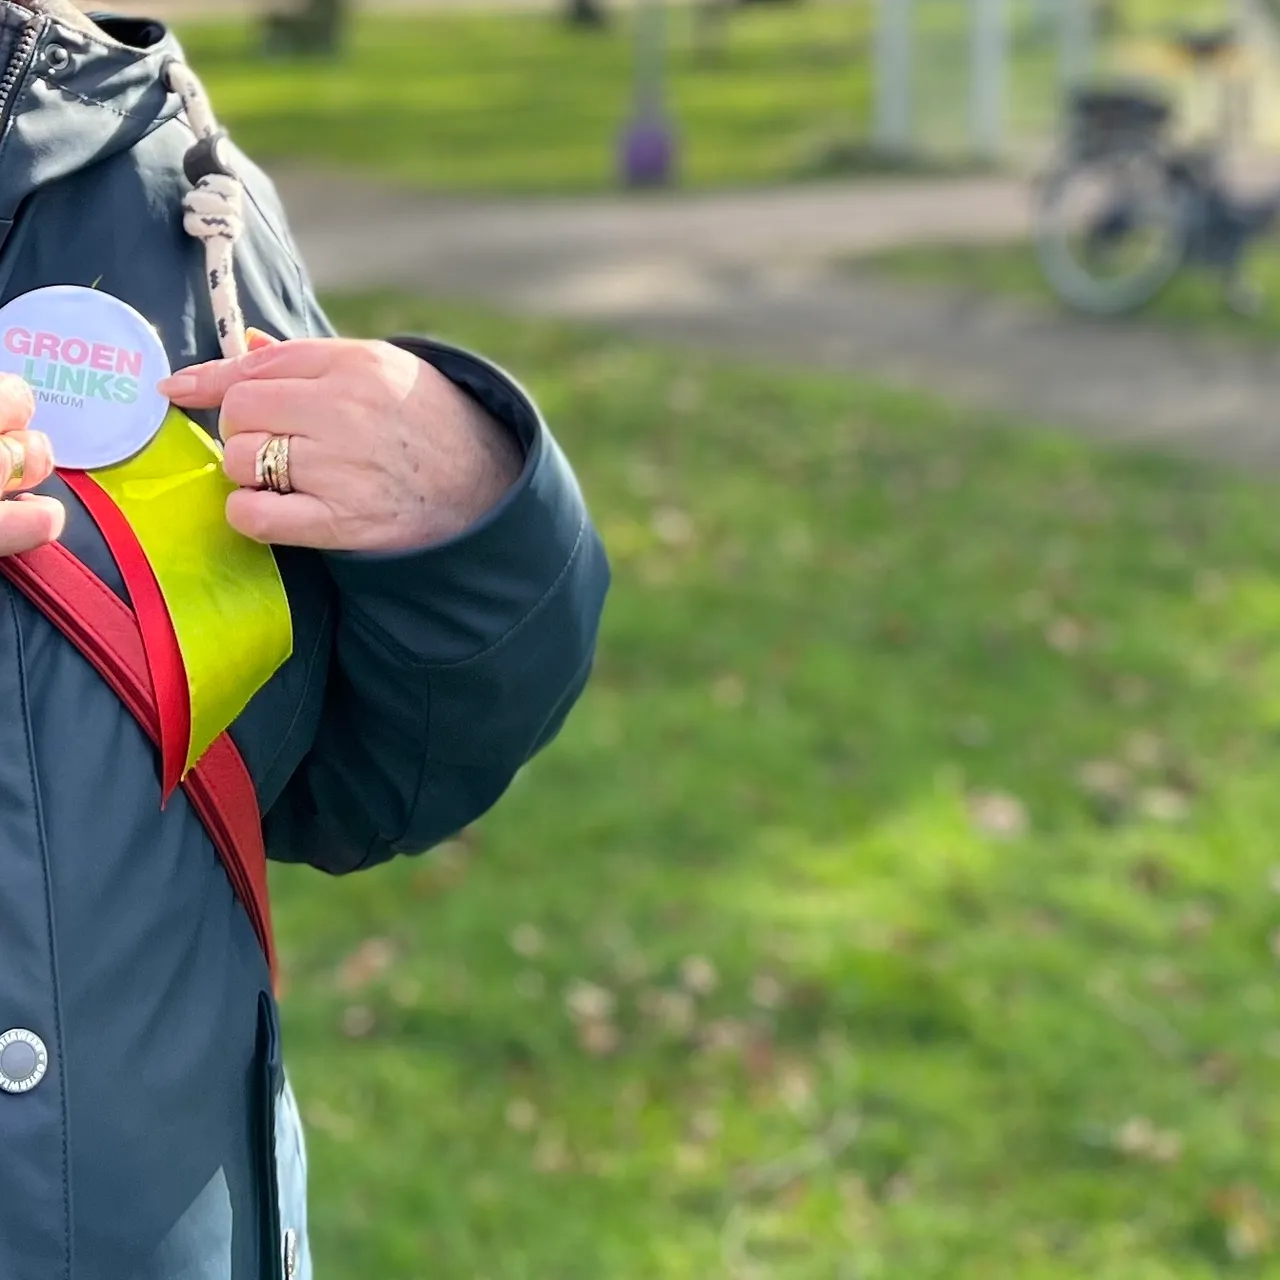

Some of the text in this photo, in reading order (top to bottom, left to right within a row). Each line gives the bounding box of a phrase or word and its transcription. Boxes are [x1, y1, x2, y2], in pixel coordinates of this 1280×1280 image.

[3, 327, 144, 378] GROEN
[22, 358, 140, 405] LINKS
[32, 389, 85, 409] ENKUM
